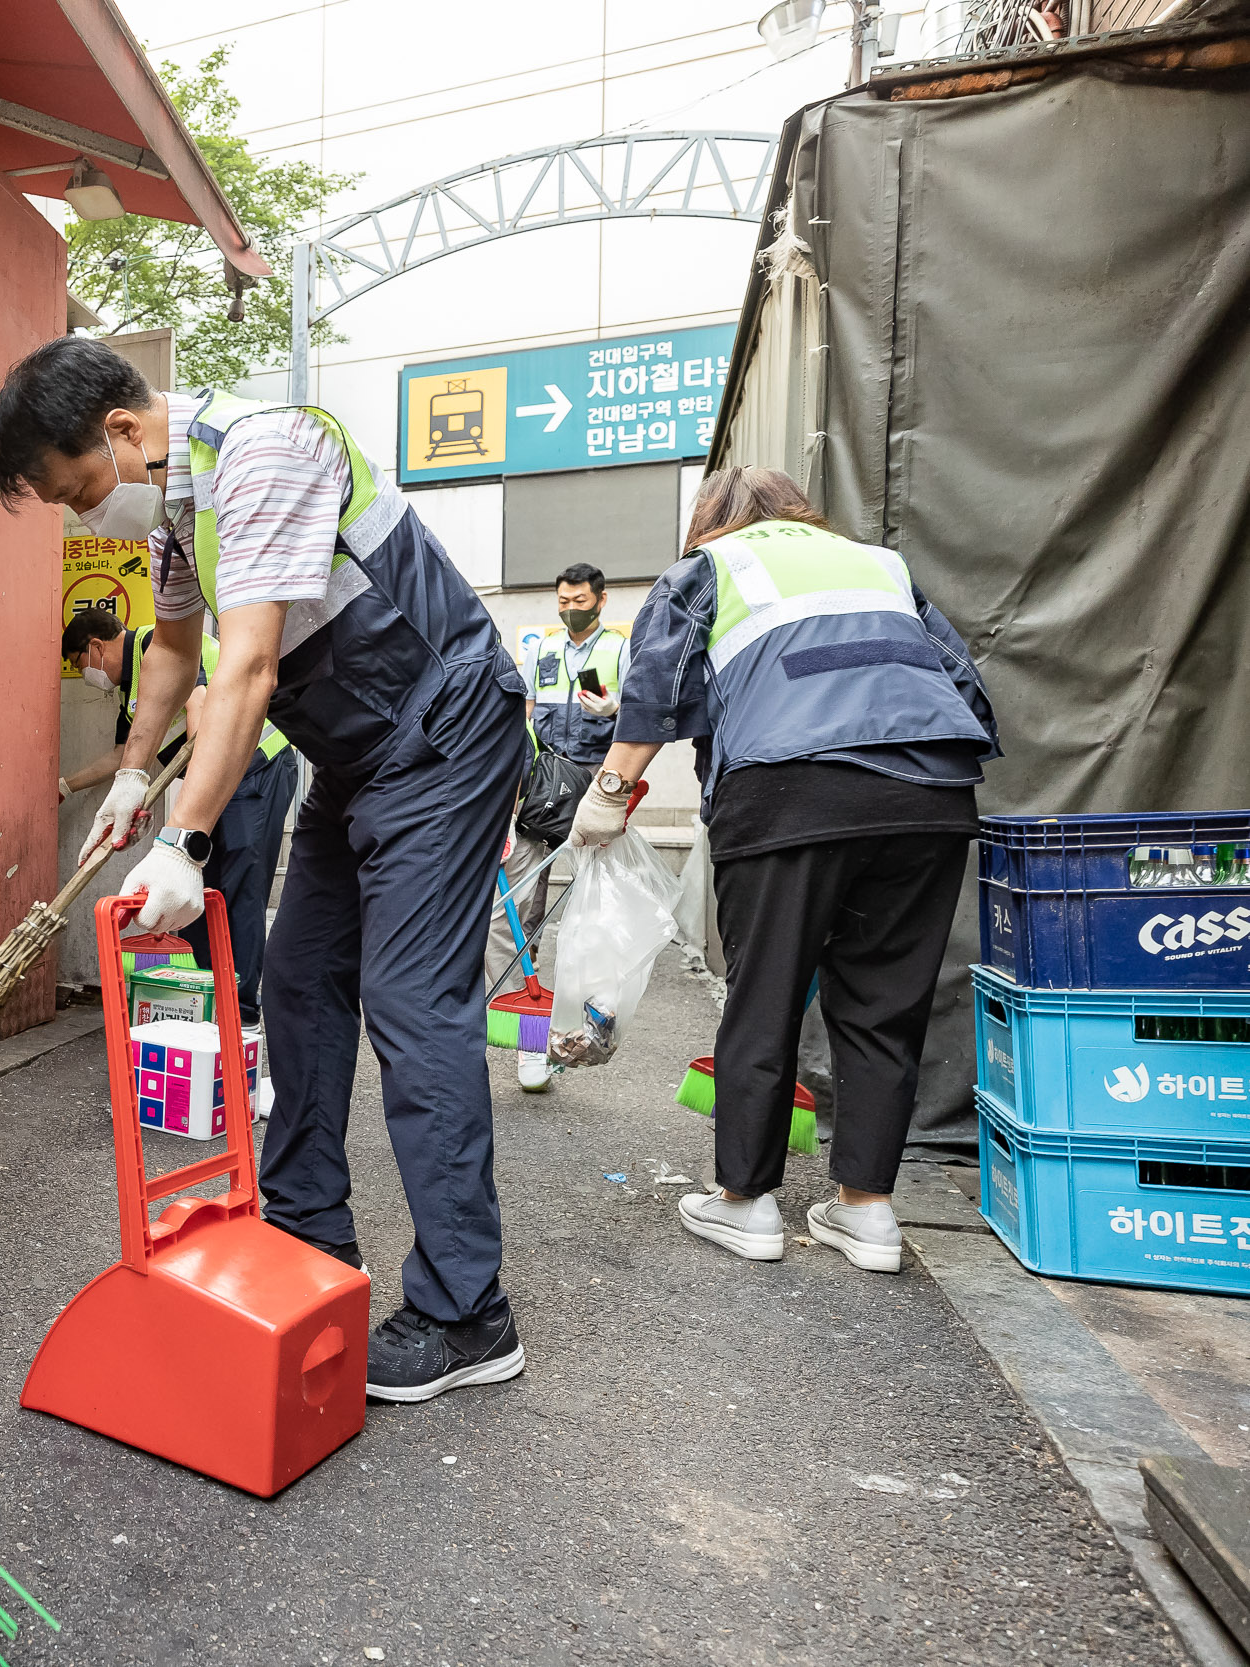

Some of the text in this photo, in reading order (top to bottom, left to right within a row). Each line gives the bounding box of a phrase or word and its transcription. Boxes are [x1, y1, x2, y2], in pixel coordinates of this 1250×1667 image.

[588, 341, 673, 367] 건대입구역
[587, 400, 672, 425] 건대입구역
[586, 420, 676, 457] 만남의
[75, 560, 113, 571] 있습니다.
[993, 904, 1012, 935] 카스
[1164, 952, 1193, 961] SOUND
[1207, 945, 1243, 956] VITALITY
[1156, 1072, 1250, 1101] 하이트
